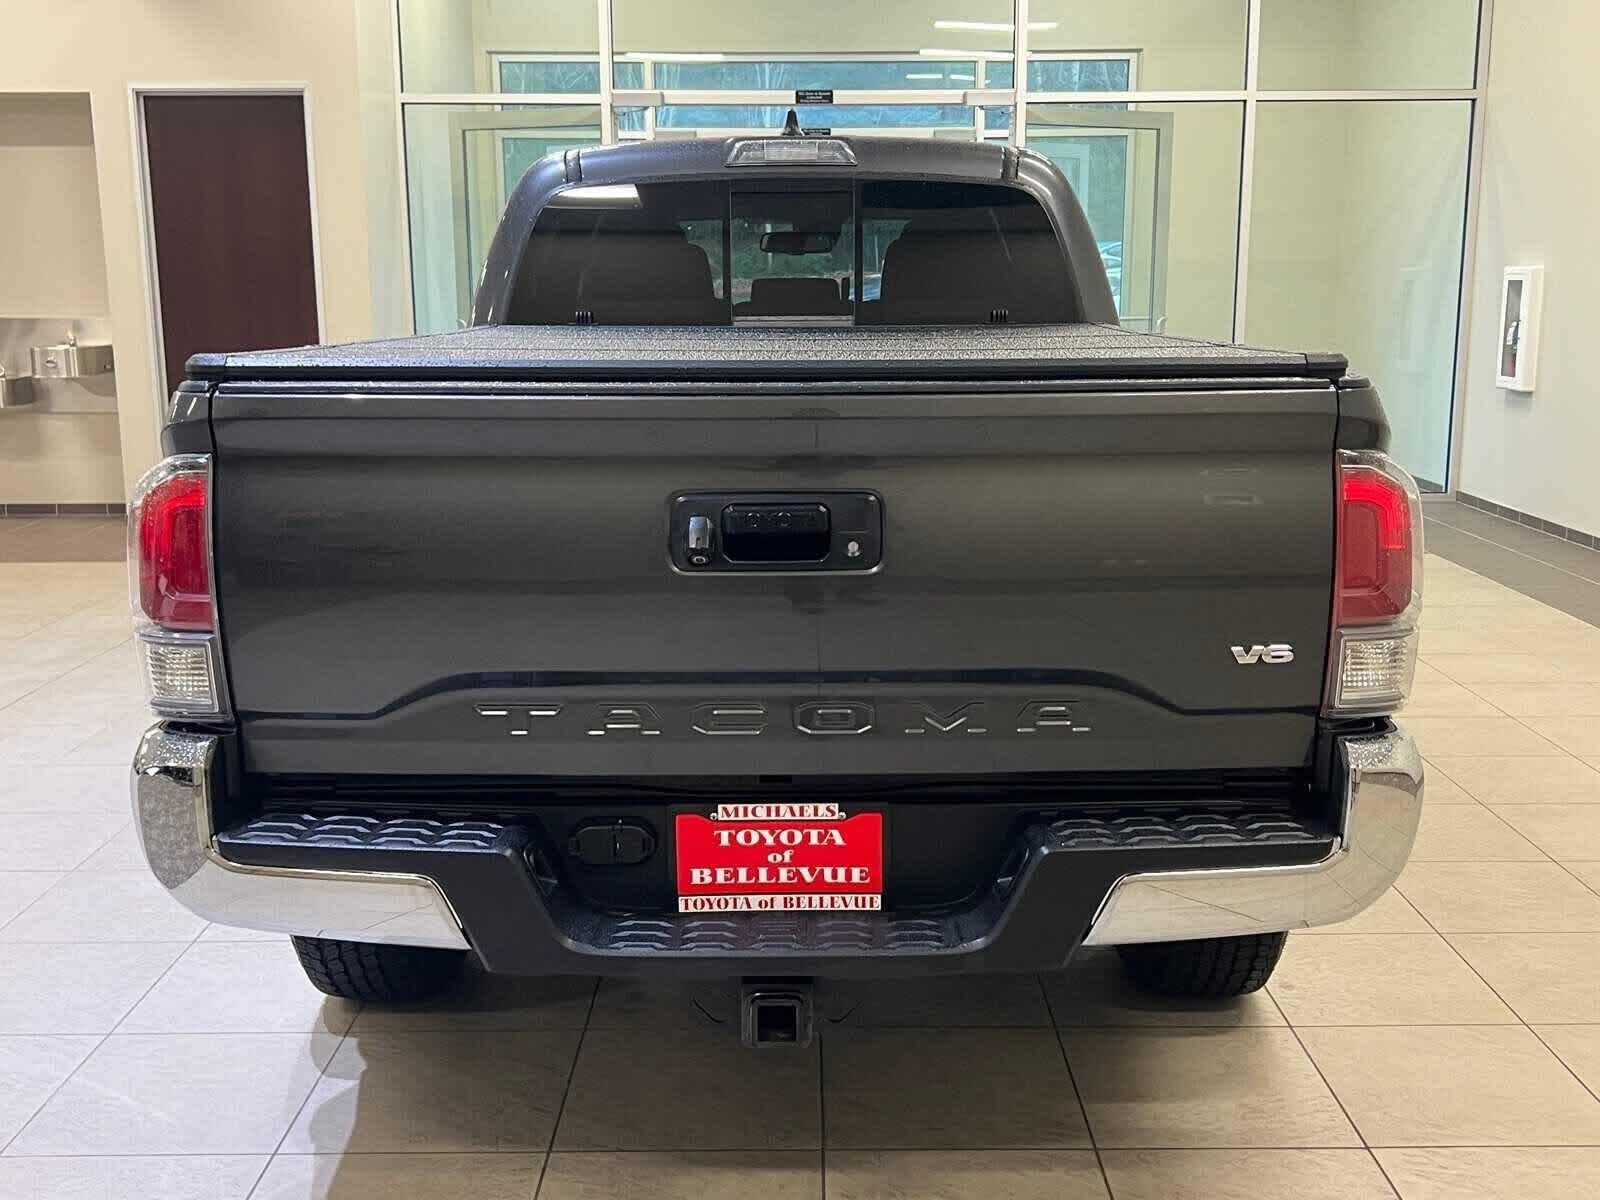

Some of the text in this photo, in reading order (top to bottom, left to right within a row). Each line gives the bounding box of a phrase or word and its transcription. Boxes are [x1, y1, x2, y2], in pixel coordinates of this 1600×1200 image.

[1231, 644, 1294, 664] V6
[474, 699, 1092, 735] TACOMA
[721, 805, 836, 818] MICHAELS
[714, 829, 846, 846] TOYOTA
[768, 850, 794, 863] of
[690, 867, 870, 884] BELLEVUE
[680, 896, 880, 910] TOYOTA of BELLEVUE
